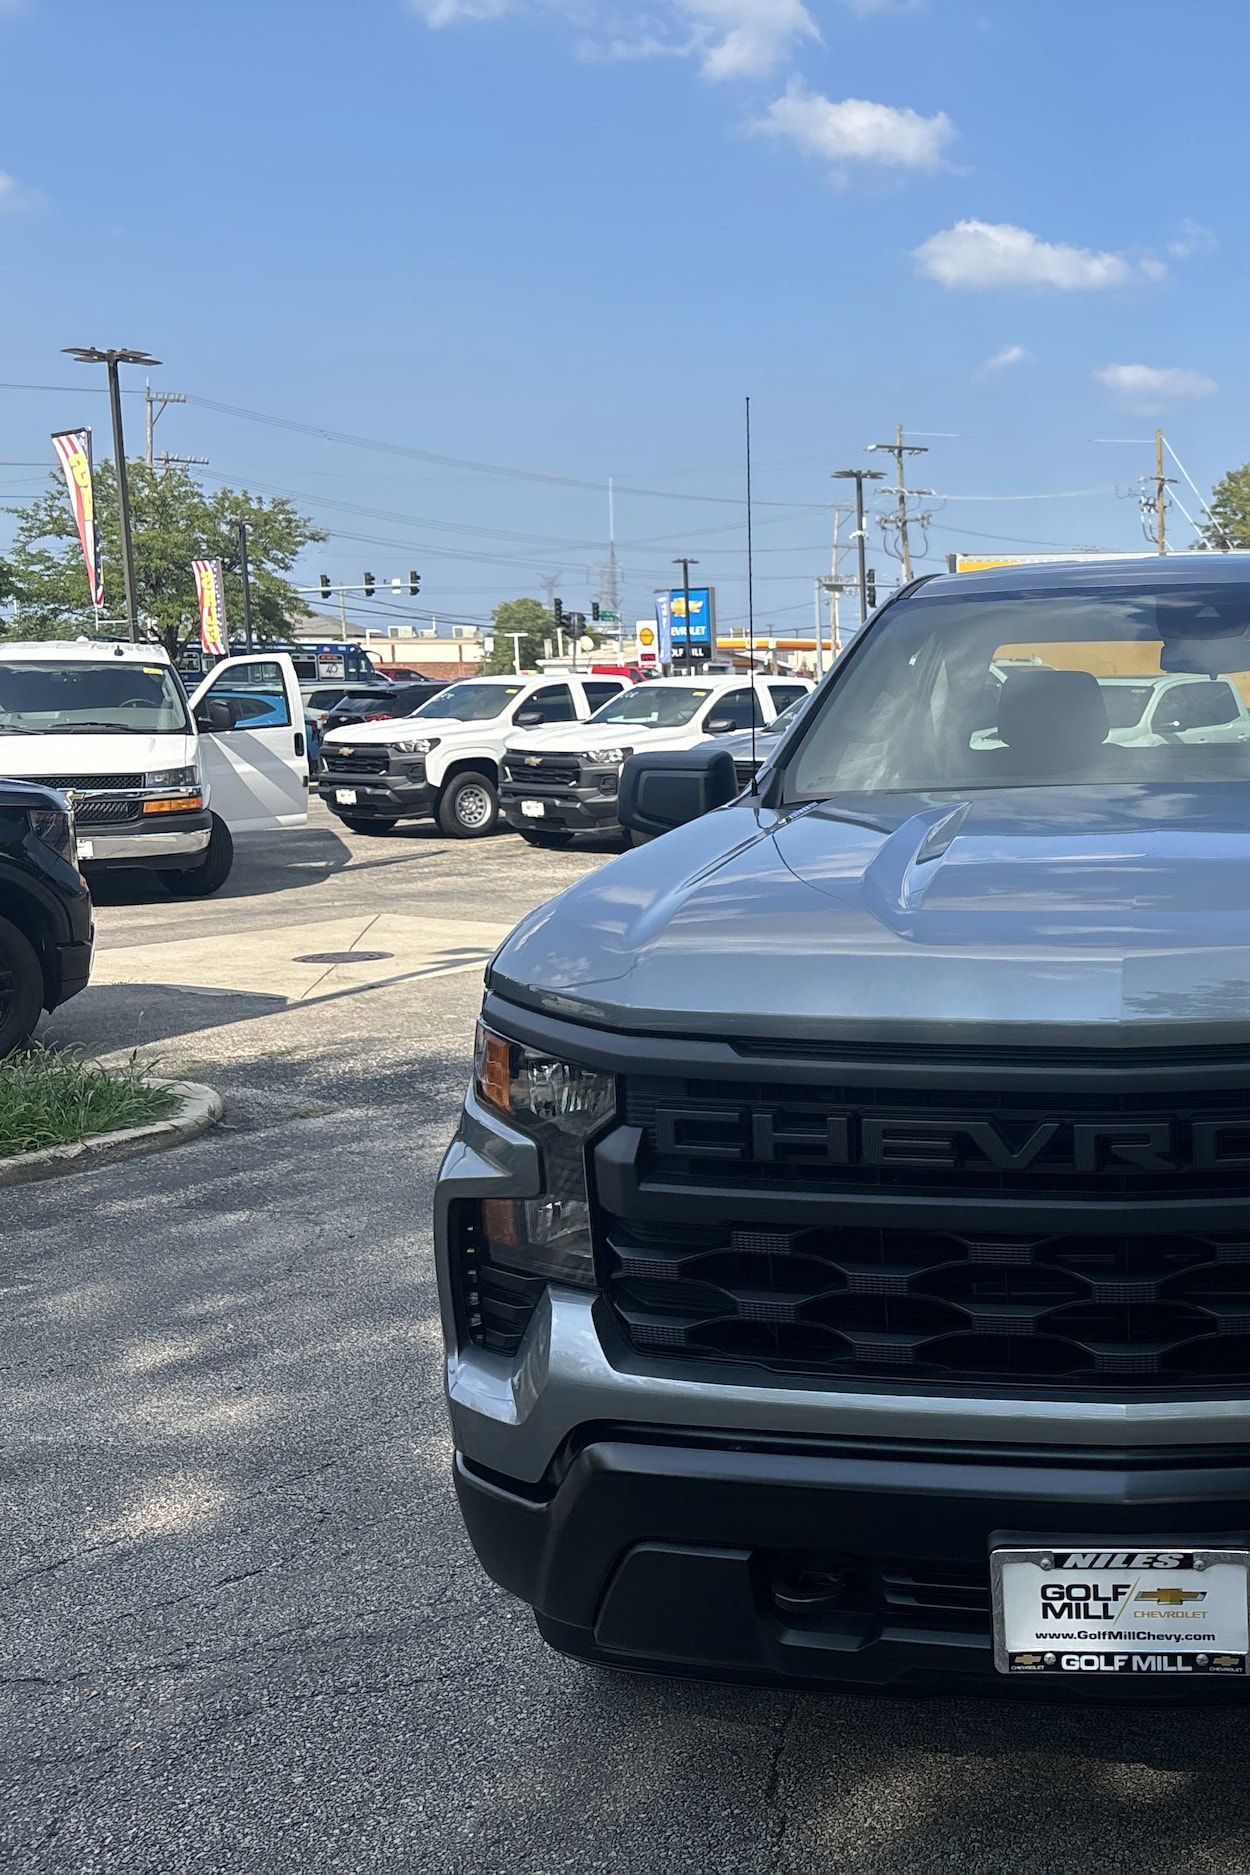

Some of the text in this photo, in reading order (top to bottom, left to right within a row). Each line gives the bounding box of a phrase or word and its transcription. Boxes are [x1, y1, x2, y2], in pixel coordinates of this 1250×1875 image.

[670, 626, 706, 637] EVRLET
[1063, 1553, 1184, 1569] NILES
[1041, 1584, 1131, 1601] GOLF
[1042, 1603, 1115, 1619] MILL
[1133, 1610, 1209, 1619] CHEVROLET
[1035, 1630, 1216, 1643] www.GolfMillChevy.com
[1061, 1654, 1193, 1671] GOLF MILL
